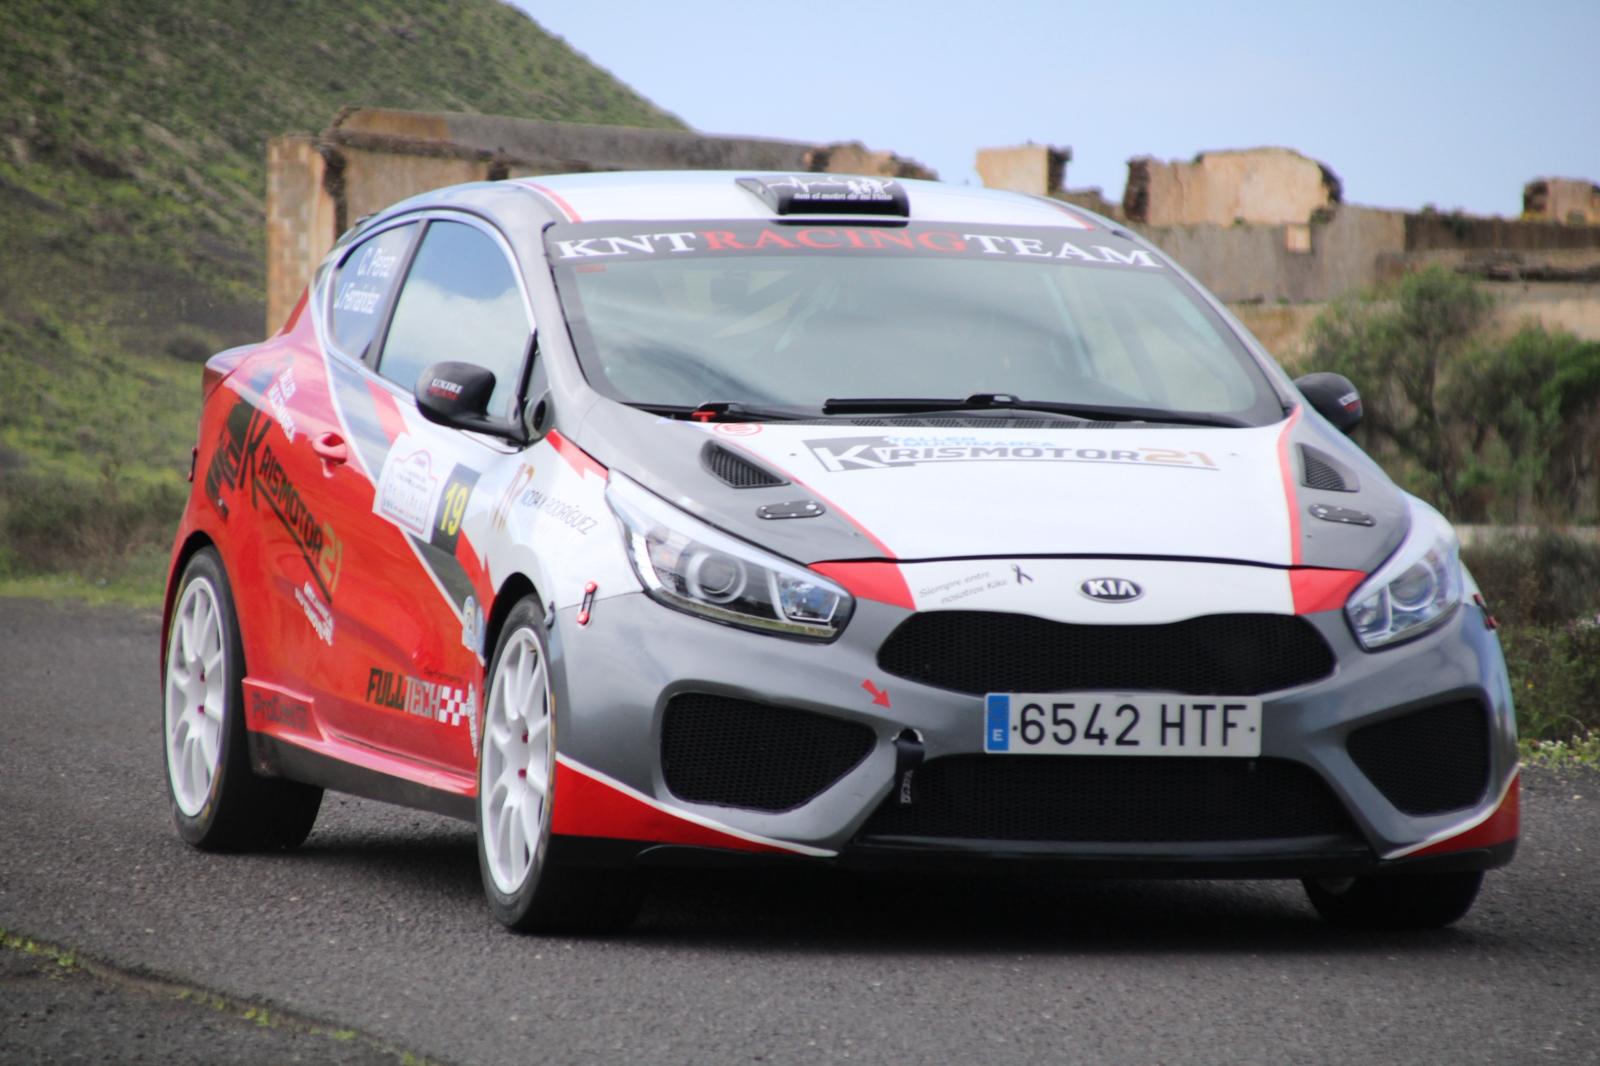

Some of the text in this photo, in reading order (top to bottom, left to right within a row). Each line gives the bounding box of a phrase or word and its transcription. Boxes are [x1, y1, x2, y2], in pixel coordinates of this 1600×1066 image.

[441, 481, 469, 537] 19
[1086, 580, 1138, 597] KIA
[365, 667, 443, 723] FULLTECH
[992, 703, 1248, 747] E 6542 HTF
